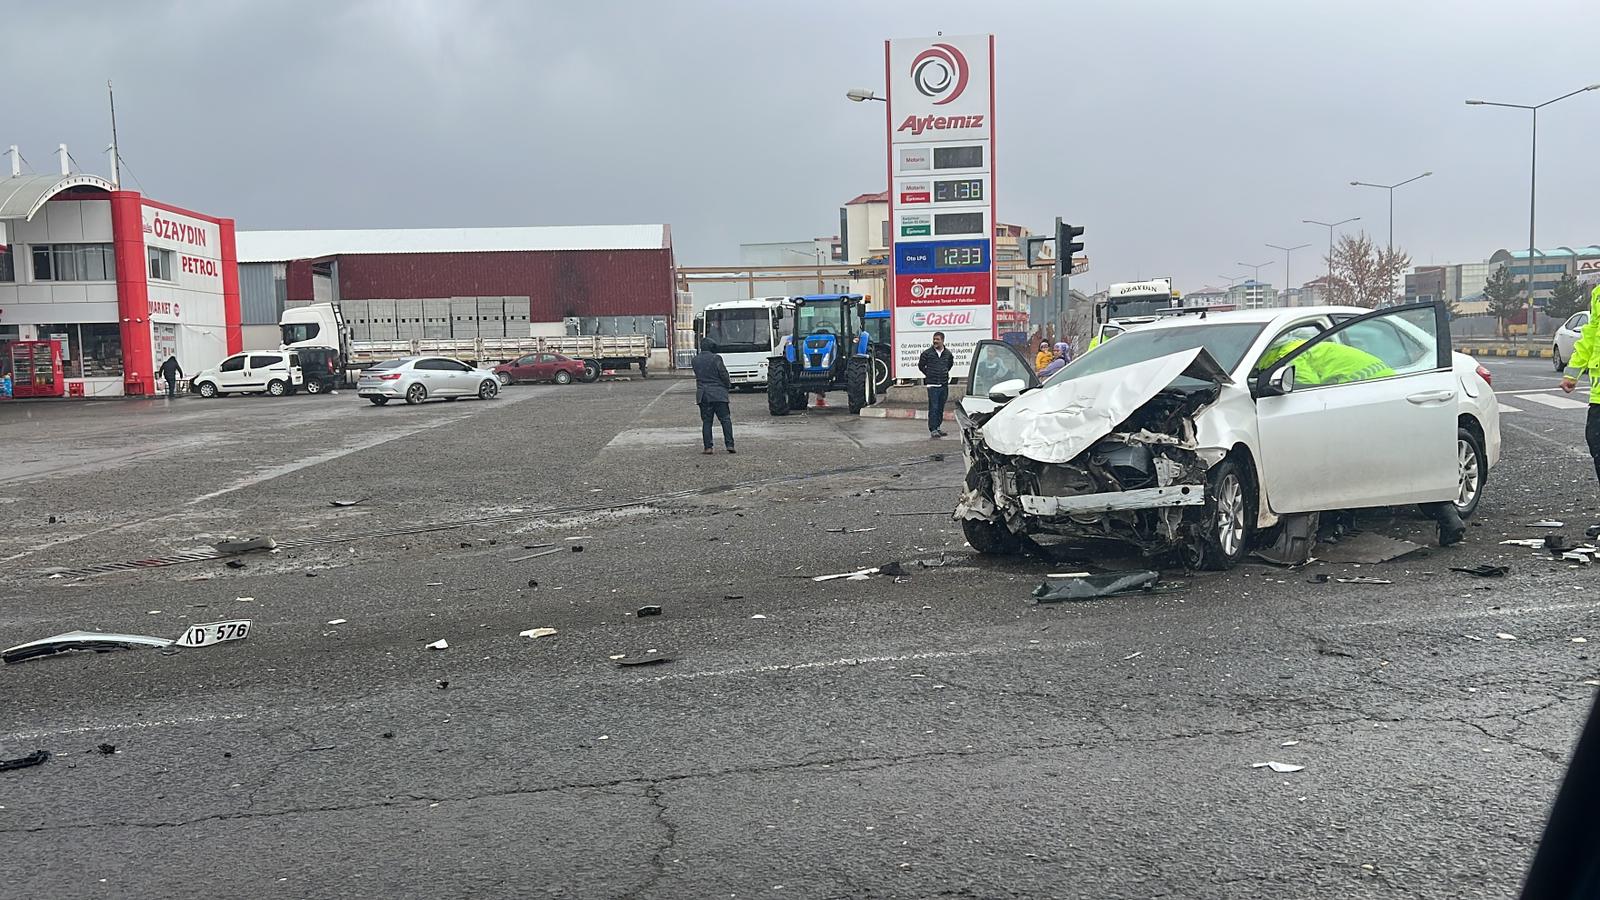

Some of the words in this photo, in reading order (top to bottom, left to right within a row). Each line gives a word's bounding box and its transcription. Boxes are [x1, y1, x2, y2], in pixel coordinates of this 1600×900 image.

[897, 114, 984, 136] Aytemiz
[154, 212, 206, 247] ÖZAYDIN
[944, 248, 981, 265] 12.33
[182, 256, 218, 277] PETROL
[911, 283, 976, 299] Optimum
[148, 301, 171, 315] MARKET
[926, 312, 971, 326] Castrol
[216, 623, 247, 641] 576
